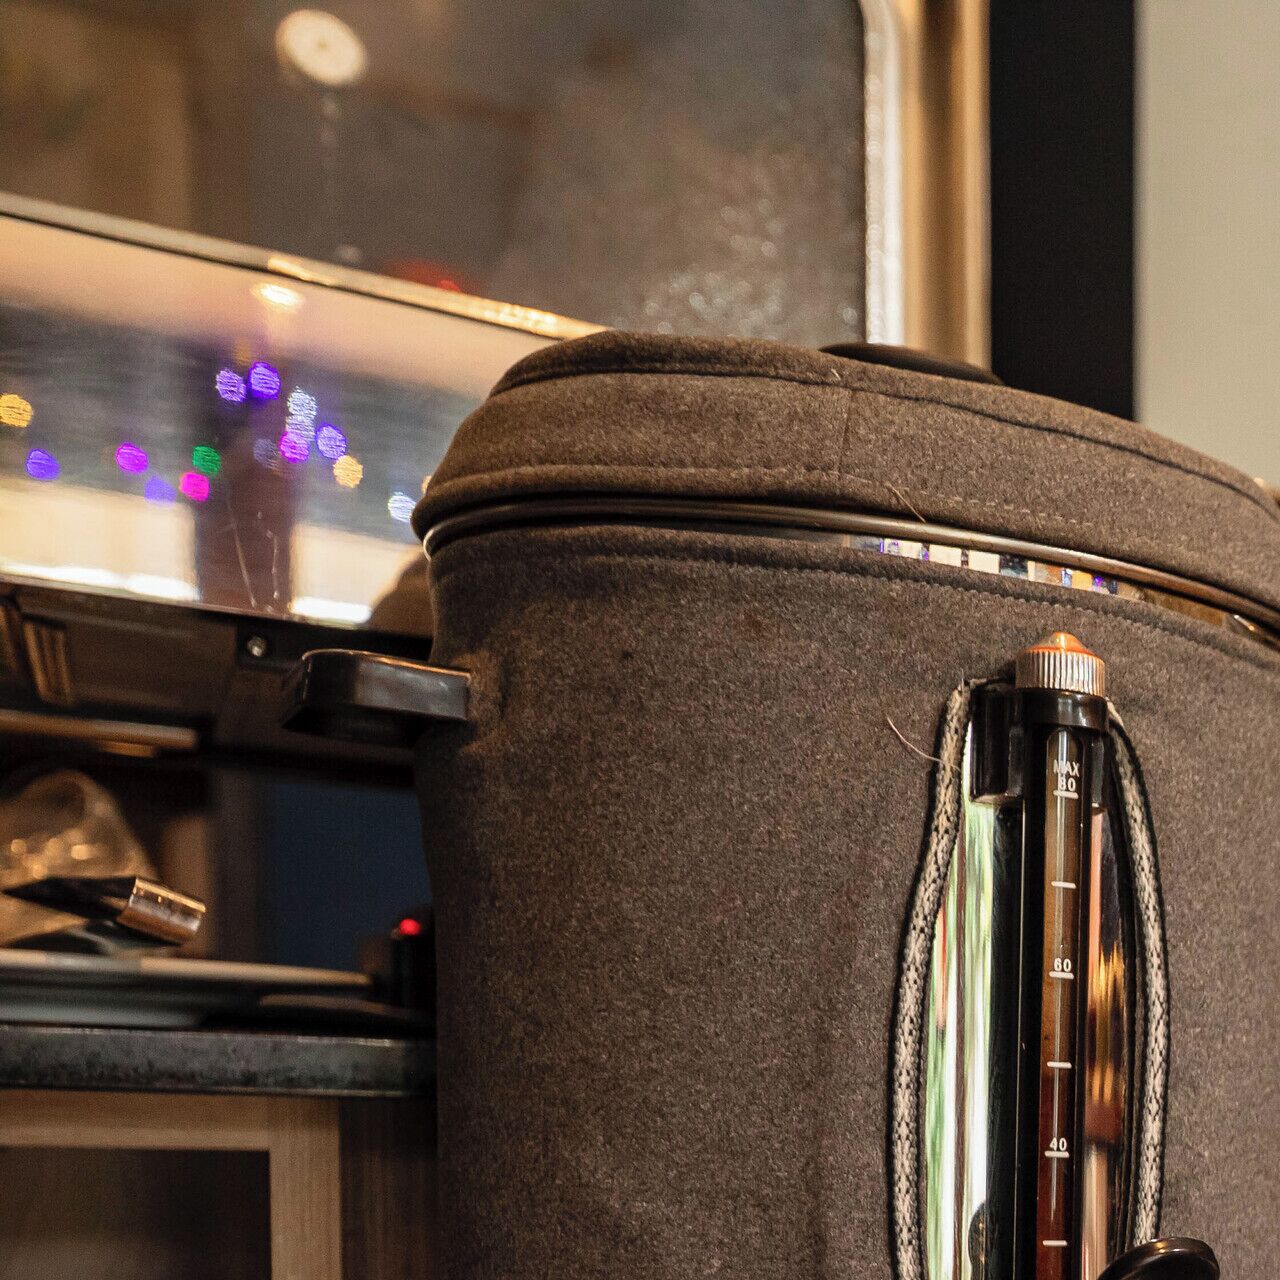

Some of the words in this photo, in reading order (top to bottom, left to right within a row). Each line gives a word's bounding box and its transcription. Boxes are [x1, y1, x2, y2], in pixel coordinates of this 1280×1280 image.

[1053, 759, 1080, 777] MAX
[1053, 957, 1072, 972] 60
[1049, 1137, 1067, 1152] 40
